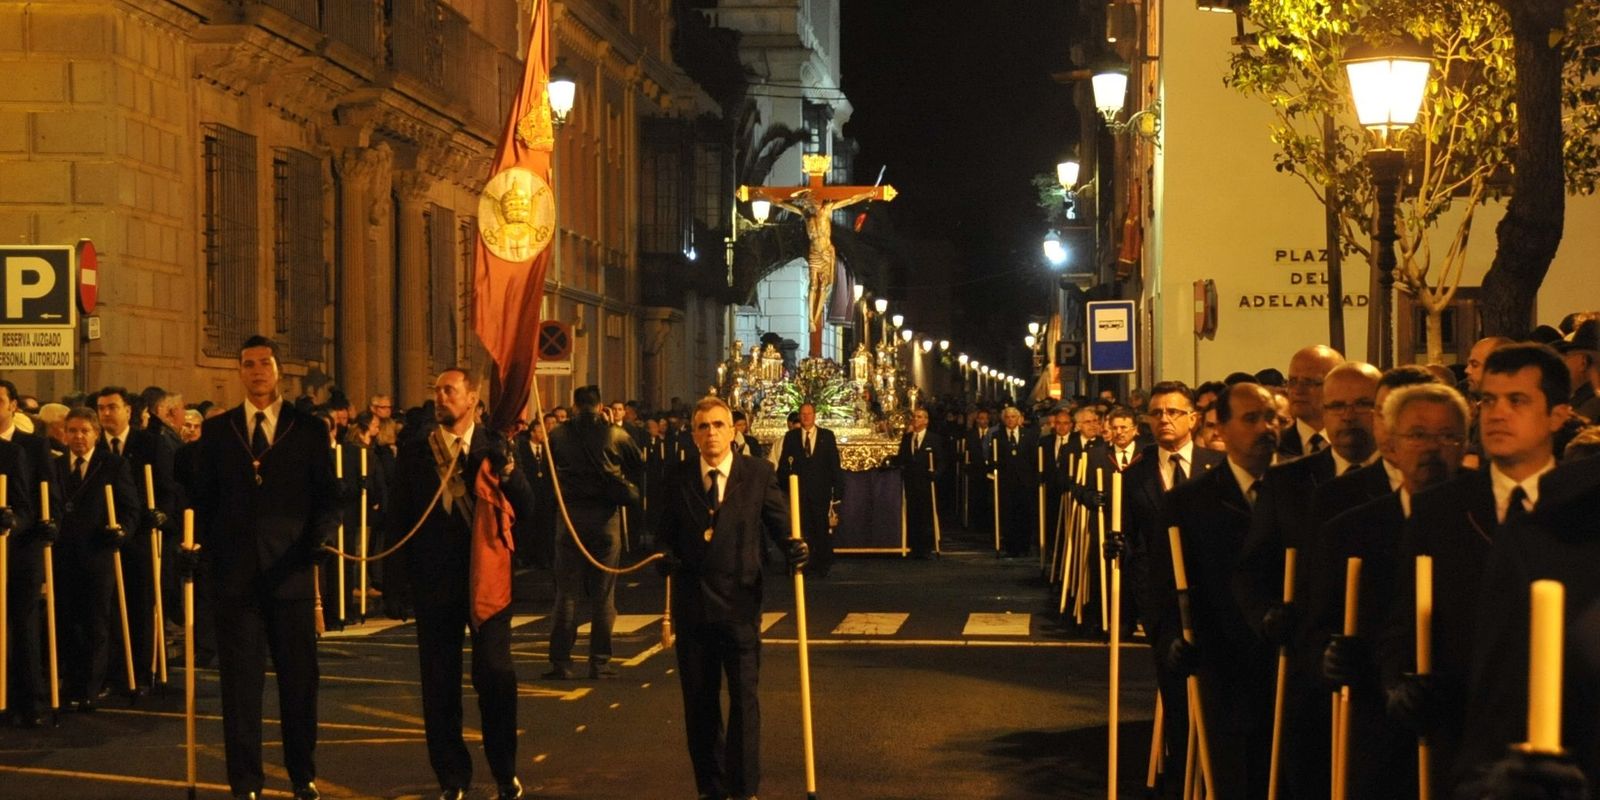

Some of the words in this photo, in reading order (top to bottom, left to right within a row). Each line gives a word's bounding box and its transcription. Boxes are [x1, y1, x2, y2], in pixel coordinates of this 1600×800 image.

[1291, 272, 1329, 285] DEL
[5, 256, 56, 319] P
[1239, 294, 1369, 308] ADELANAD
[2, 332, 31, 347] RESERVA
[32, 332, 61, 347] JUZGADO
[0, 351, 27, 366] ERSONAL
[29, 351, 70, 366] AUTORIZADO
[1060, 344, 1077, 364] P
